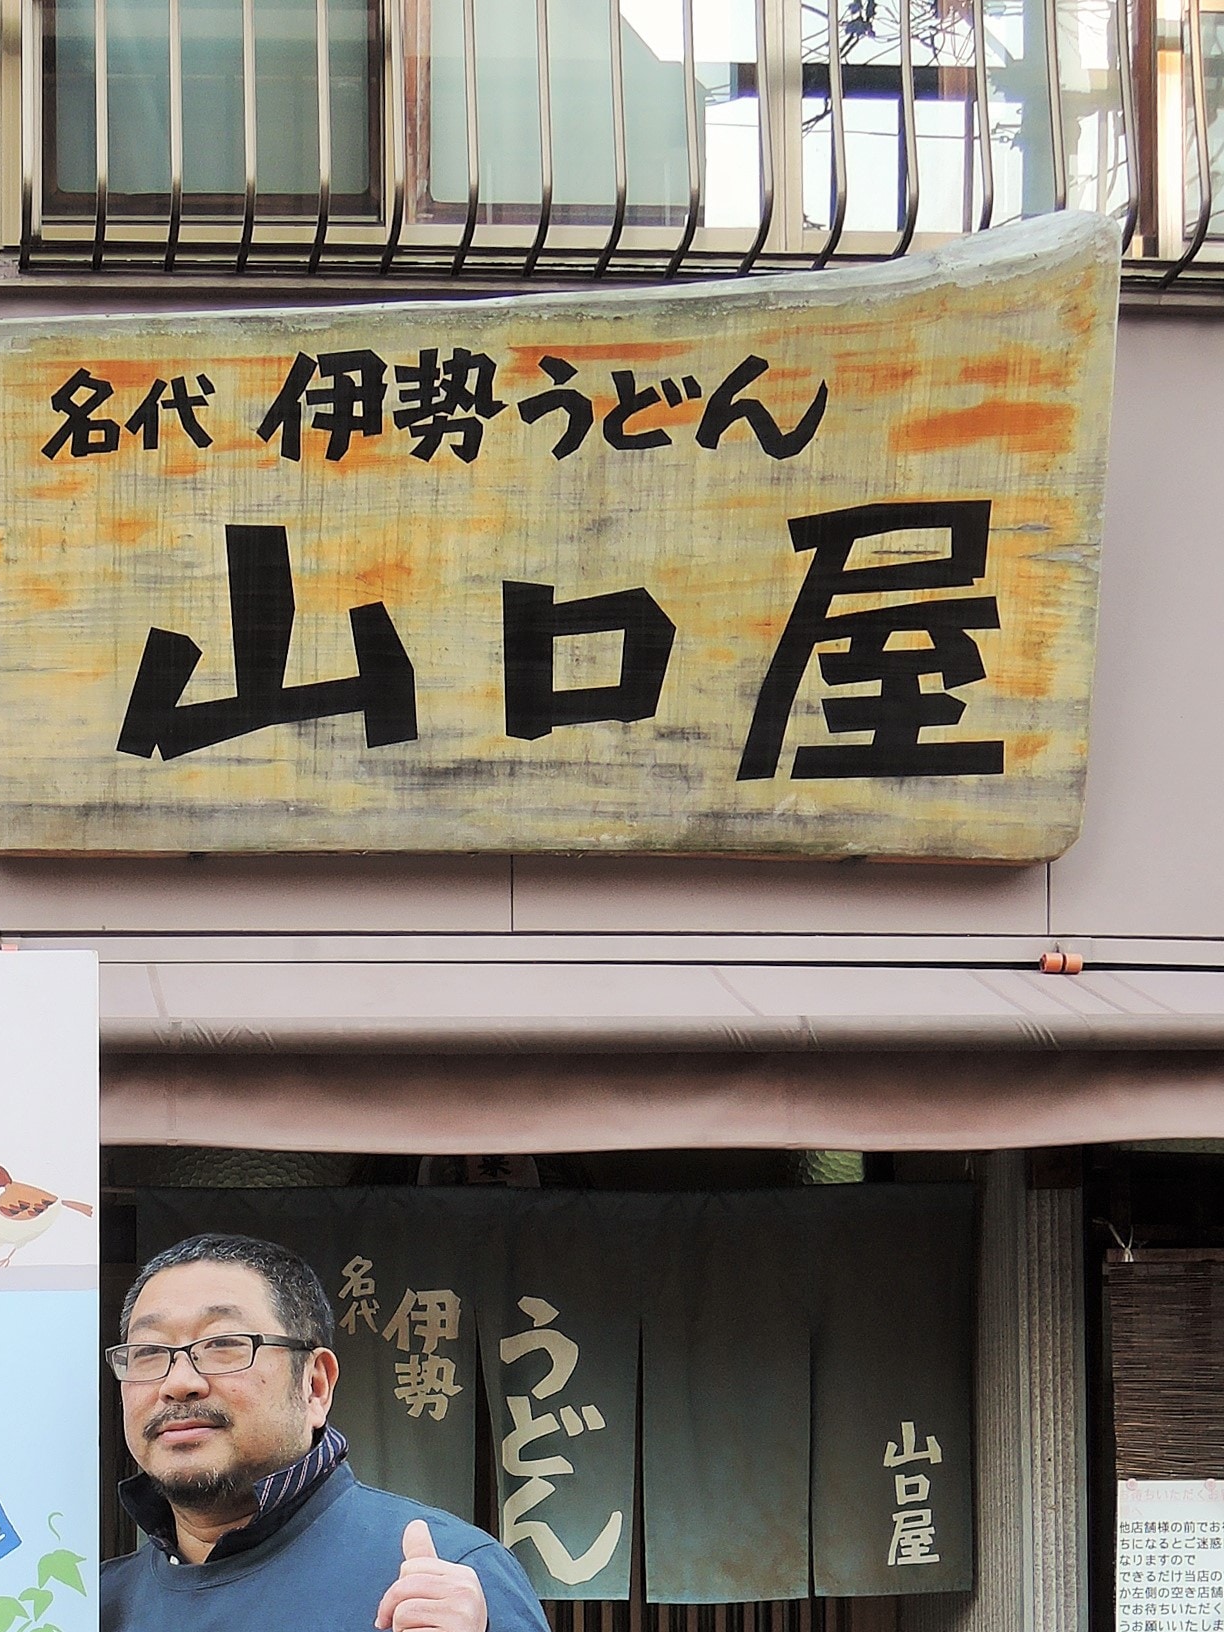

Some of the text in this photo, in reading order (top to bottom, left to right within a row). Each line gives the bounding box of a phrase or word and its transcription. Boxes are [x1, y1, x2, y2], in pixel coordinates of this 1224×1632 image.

[41, 346, 829, 465] 名代 伊勢うどん
[116, 499, 1005, 782] 山口屋
[338, 1254, 623, 1585] 名代 伊勢 うどん
[882, 1420, 944, 1567] 山口屋
[1119, 1521, 1224, 1534] 他店舗様の前でお
[1119, 1554, 1196, 1567] なりますので
